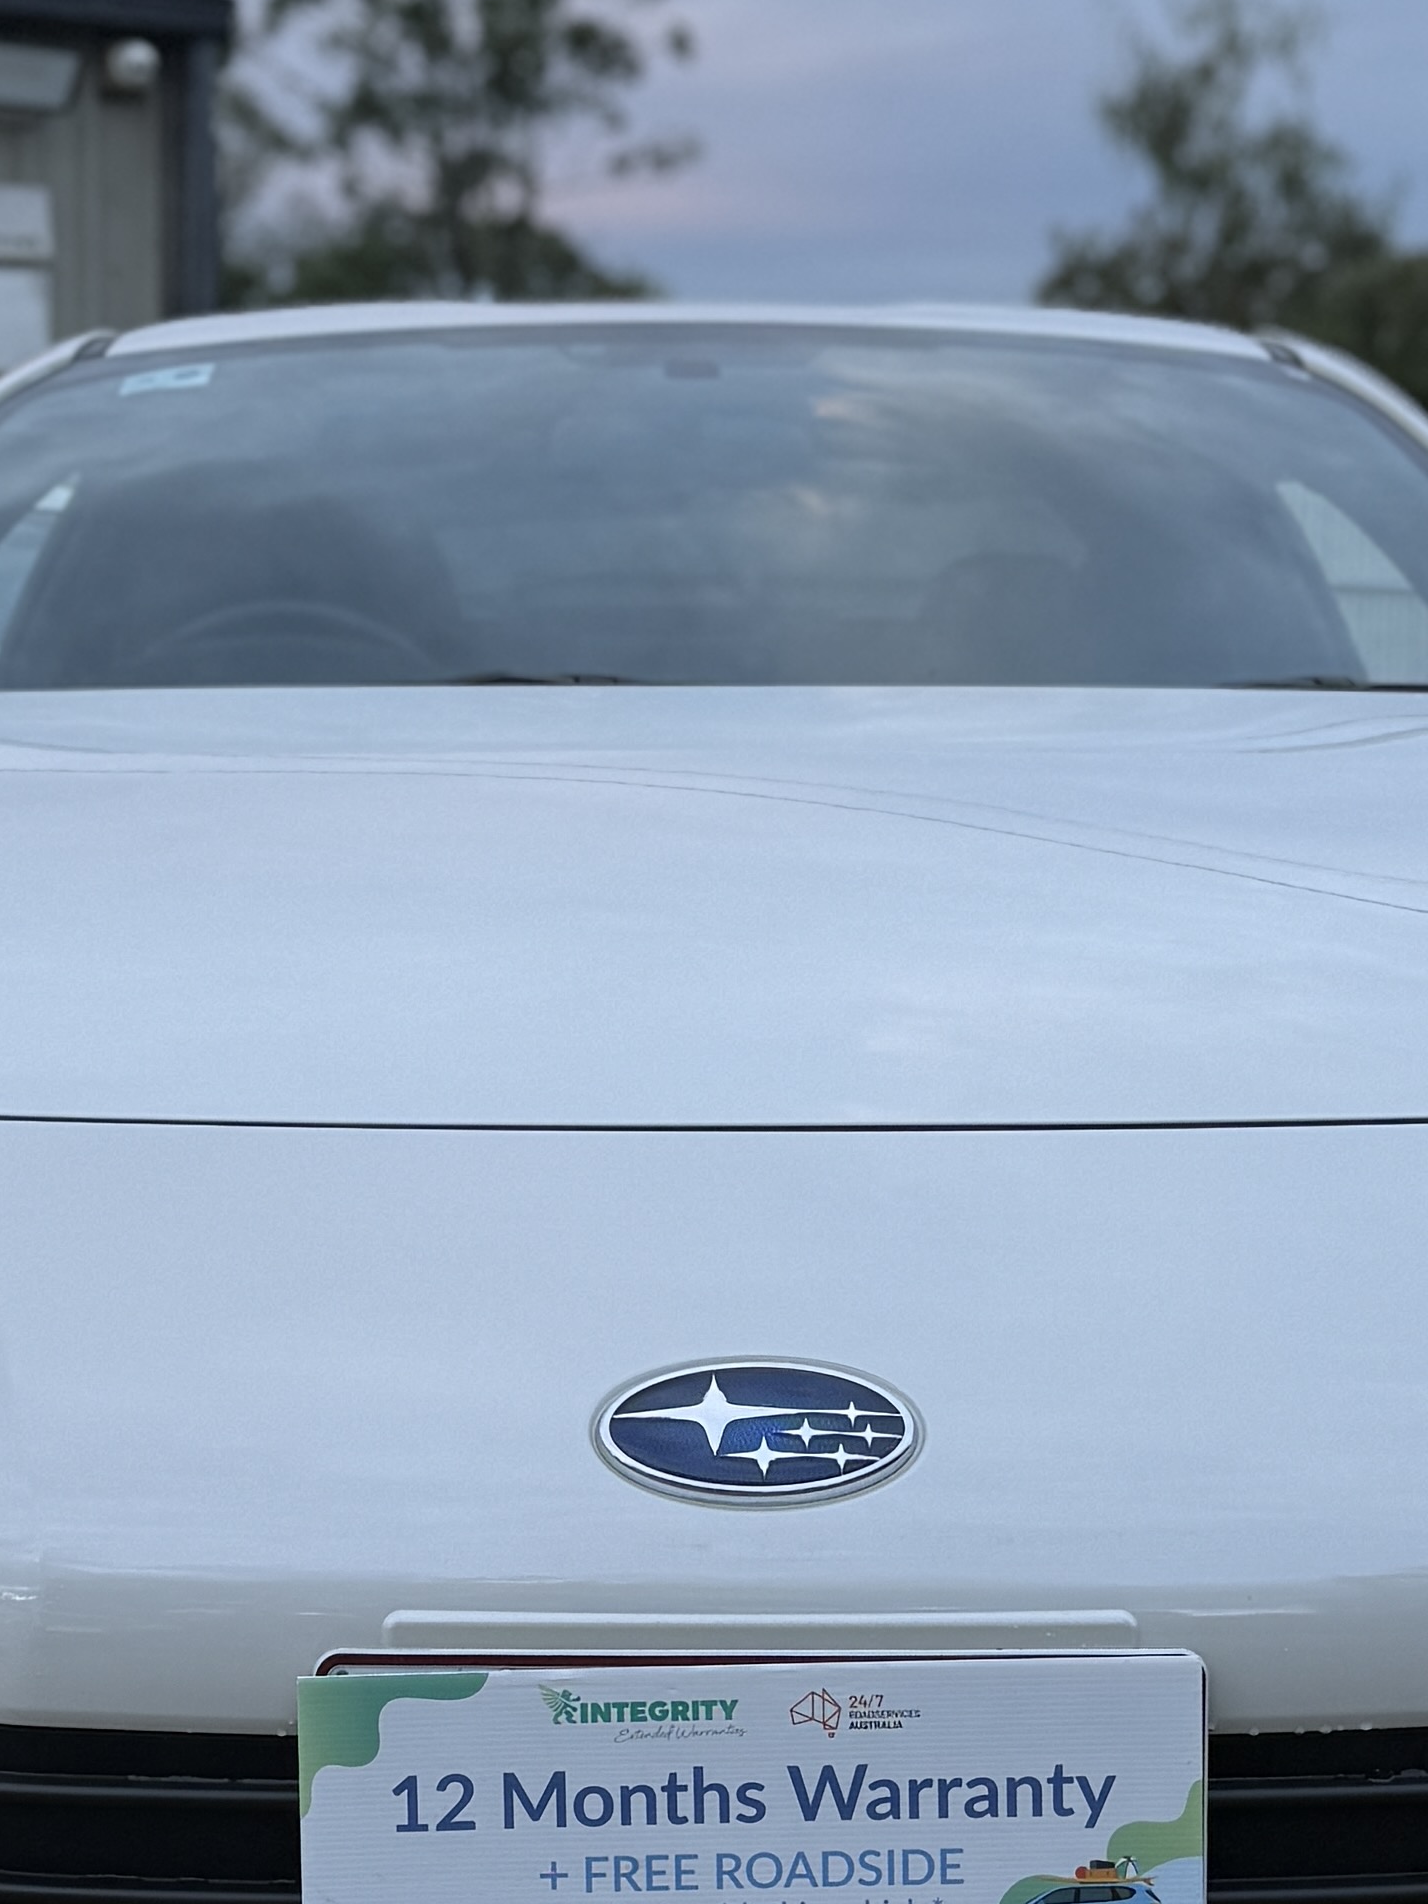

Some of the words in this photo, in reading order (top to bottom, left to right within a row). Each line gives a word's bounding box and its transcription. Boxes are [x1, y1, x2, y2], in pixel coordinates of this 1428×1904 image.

[580, 1699, 739, 1724] INTEGRITY
[848, 1694, 884, 1709] 24/7
[613, 1723, 674, 1743] Extended
[675, 1724, 747, 1741] Warranties
[848, 1719, 903, 1730] AUSTRALIA
[392, 1773, 476, 1832] 12
[503, 1766, 766, 1829] Months
[787, 1763, 1116, 1829] Warranty
[584, 1854, 699, 1893] FREE
[716, 1848, 965, 1890] ROADSIDE
